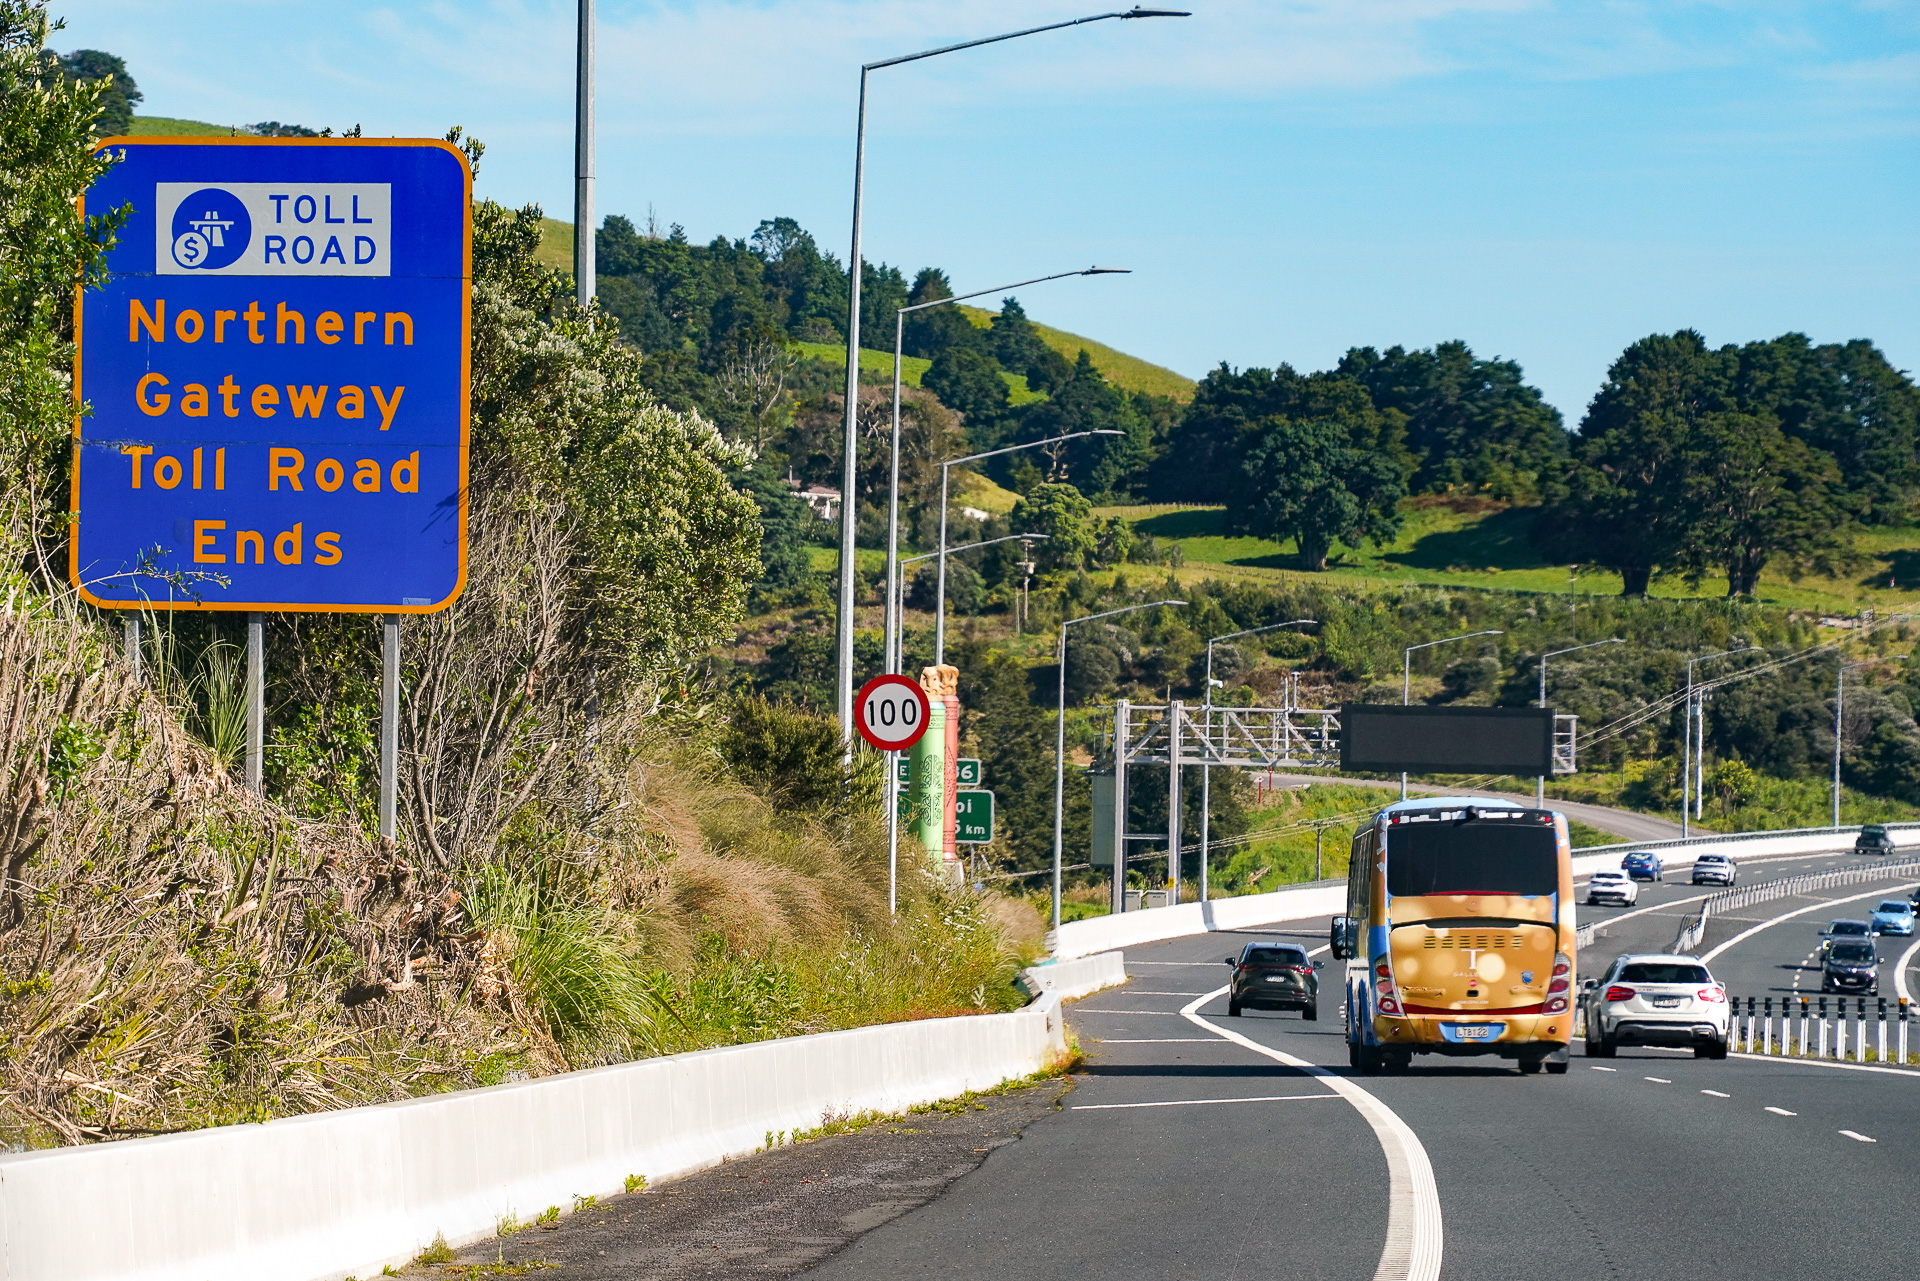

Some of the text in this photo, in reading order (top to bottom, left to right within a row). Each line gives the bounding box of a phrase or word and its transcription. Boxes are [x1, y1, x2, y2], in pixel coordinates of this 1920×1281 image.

[268, 194, 373, 224] TOLL
[264, 234, 377, 265] ROAD
[129, 298, 414, 346] Northern
[135, 372, 406, 431] Gateway
[122, 445, 420, 494] Toll Road
[193, 519, 343, 566] Ends
[868, 698, 917, 727] 100
[965, 824, 985, 835] km
